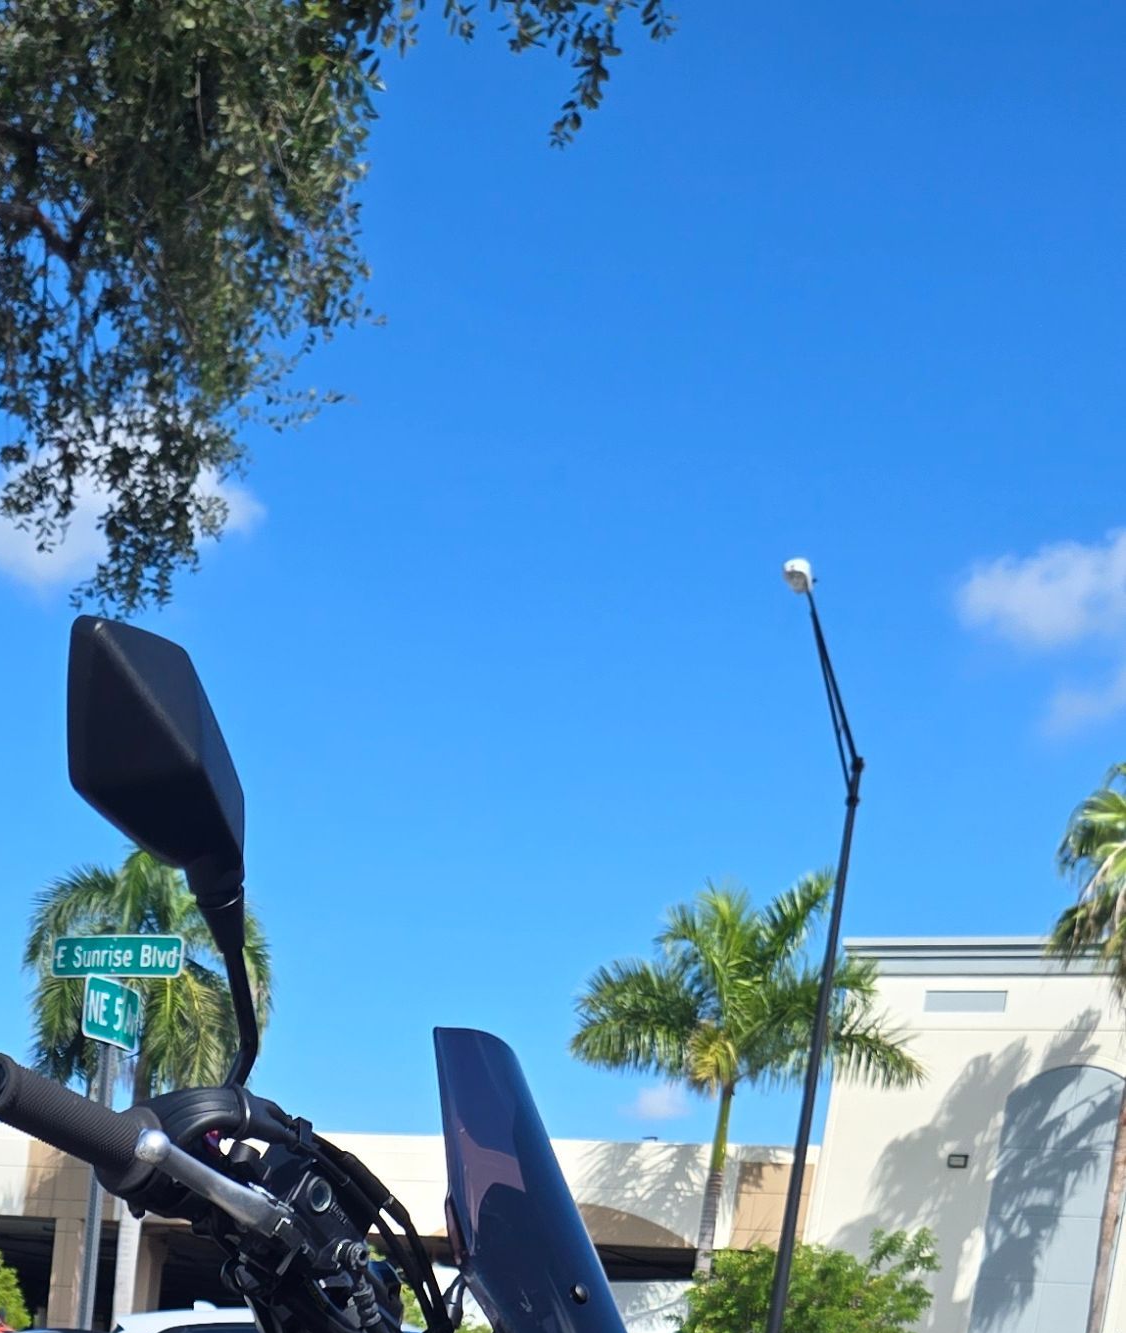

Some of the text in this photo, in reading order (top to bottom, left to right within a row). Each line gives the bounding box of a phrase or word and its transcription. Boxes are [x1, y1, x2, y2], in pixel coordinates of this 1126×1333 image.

[55, 943, 179, 969] E Sunrise Blvd
[87, 988, 111, 1028] NE
[113, 996, 124, 1032] 5
